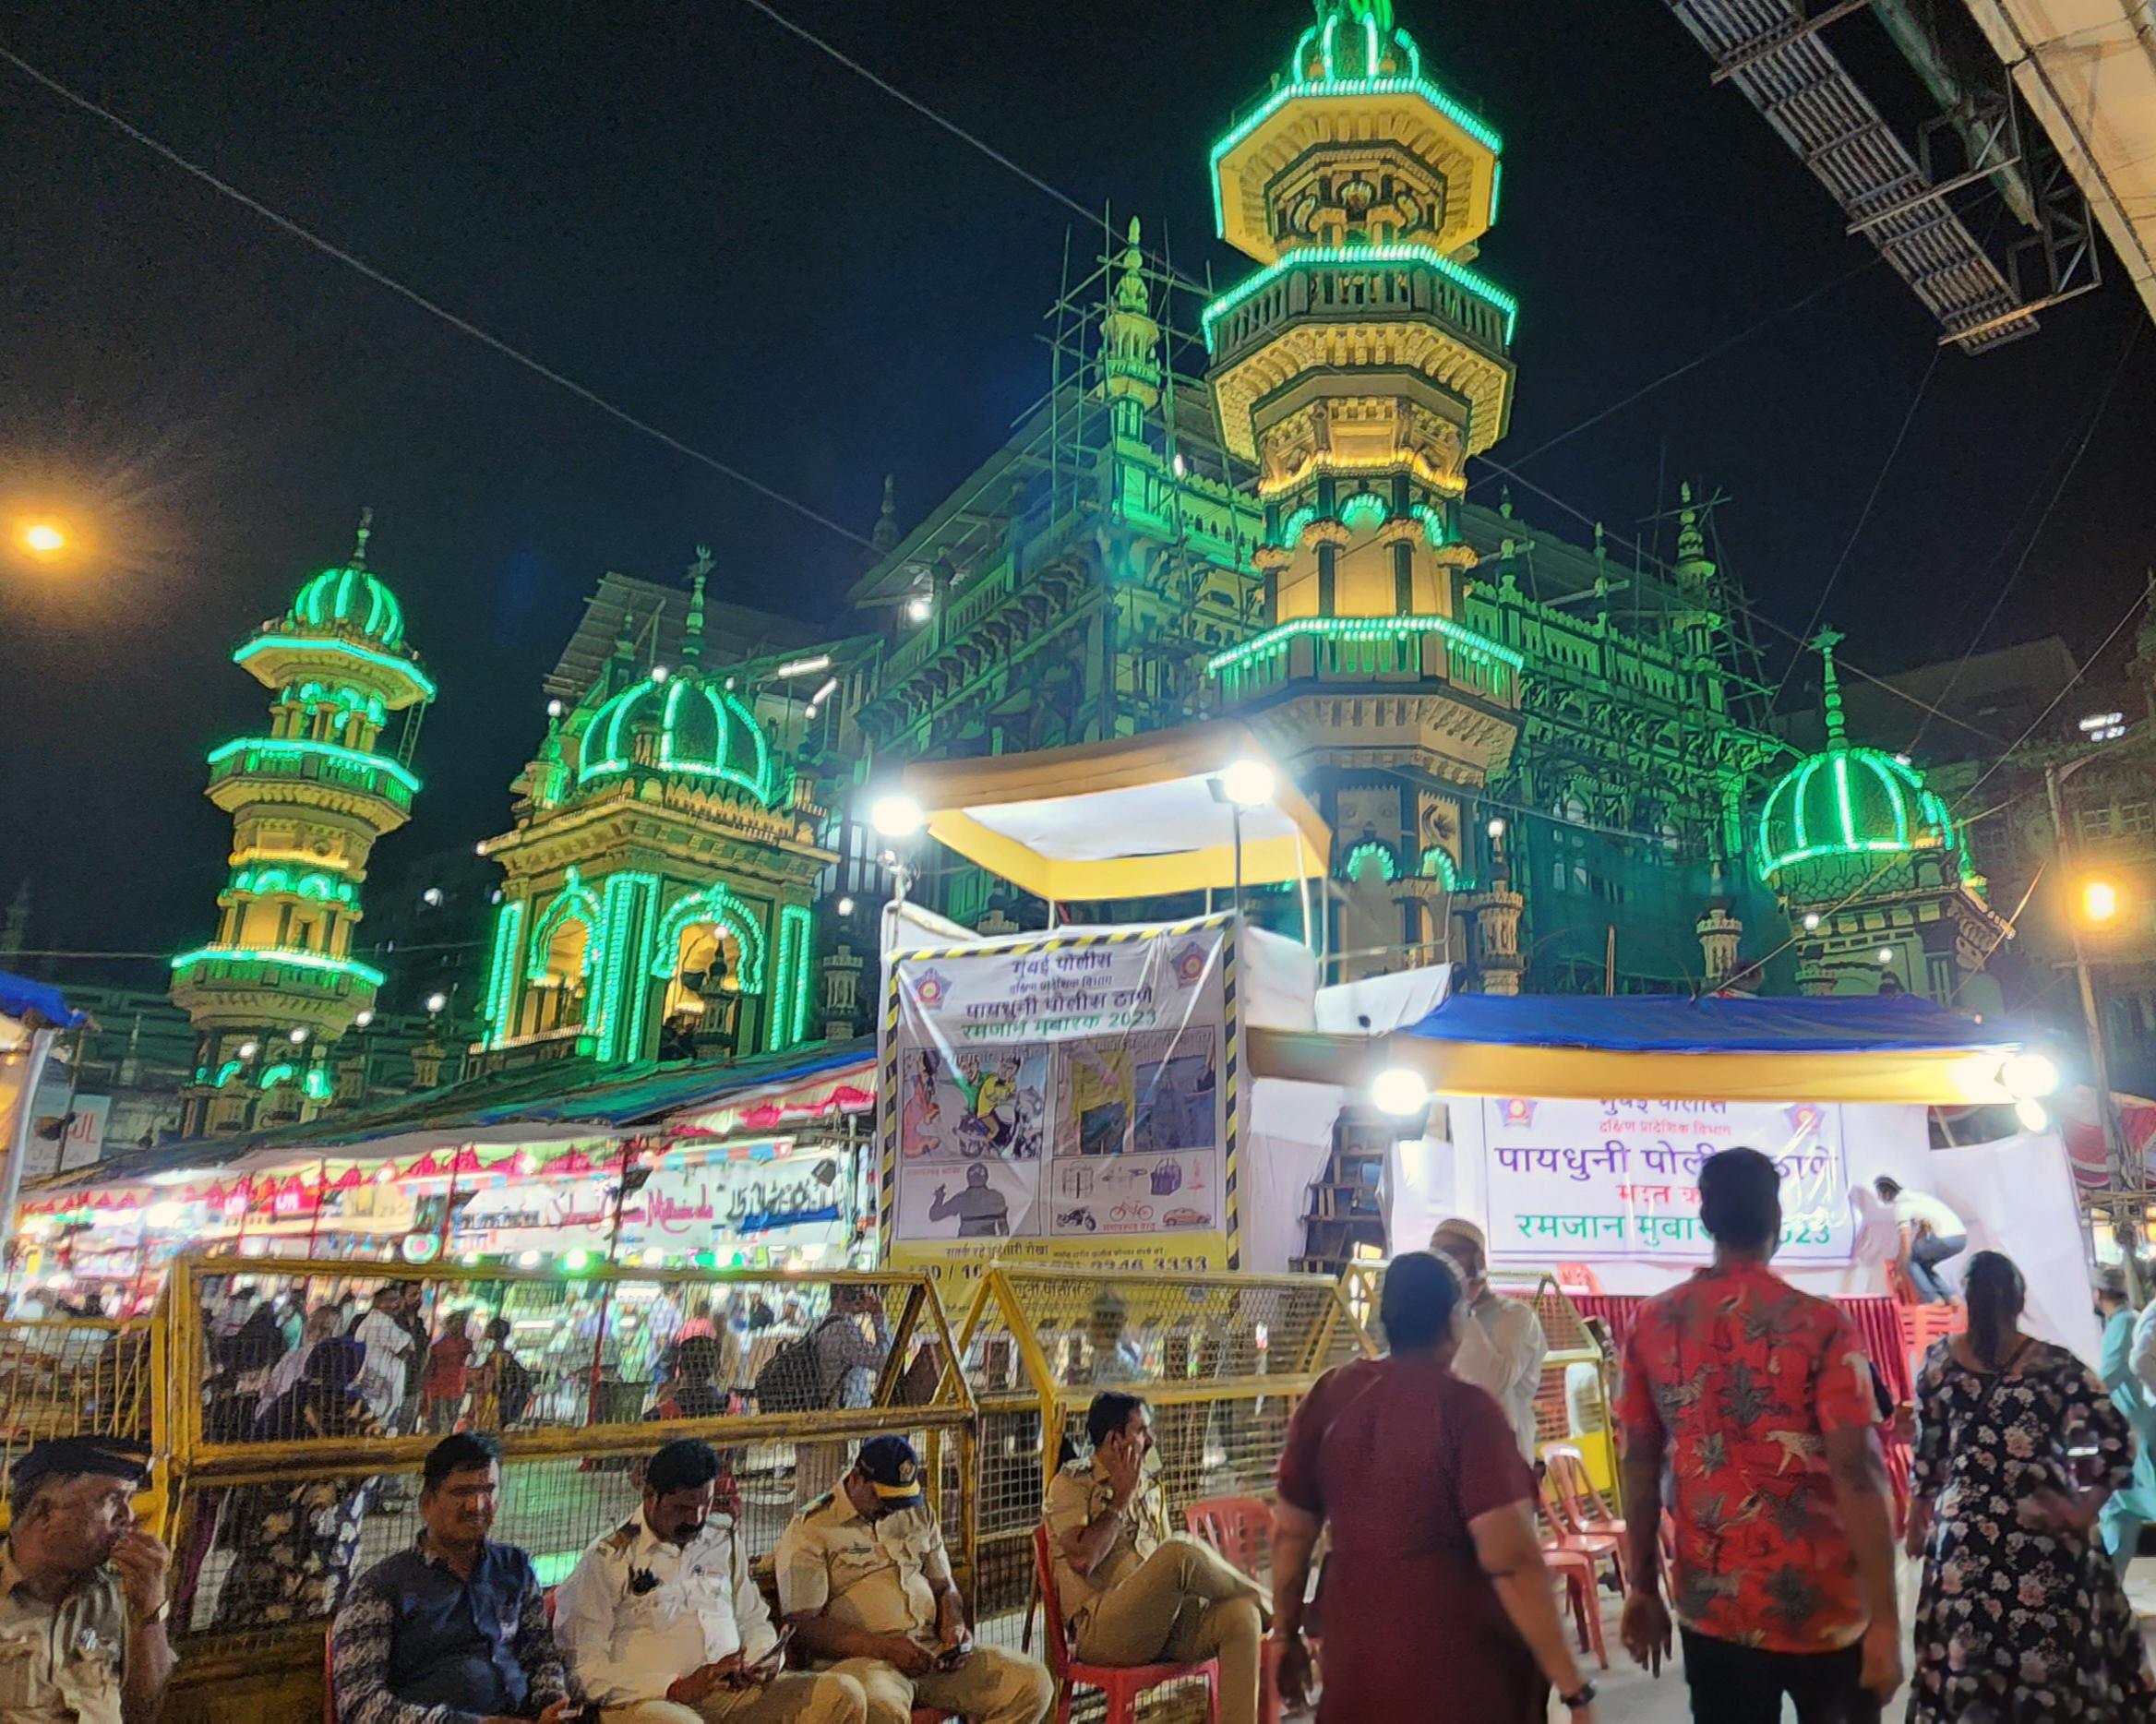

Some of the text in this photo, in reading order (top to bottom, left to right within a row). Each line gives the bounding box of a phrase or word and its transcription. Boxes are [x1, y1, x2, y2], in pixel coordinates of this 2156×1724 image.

[1056, 950, 1113, 972] पोलीस
[1045, 989, 1107, 1014] पोलीस
[1108, 1010, 1156, 1028] 2023
[1493, 1140, 1631, 1181] पायधुनी
[1640, 1140, 1716, 1176] पोली
[1515, 1215, 1626, 1239] रमजान
[1780, 1220, 1831, 1244] 023
